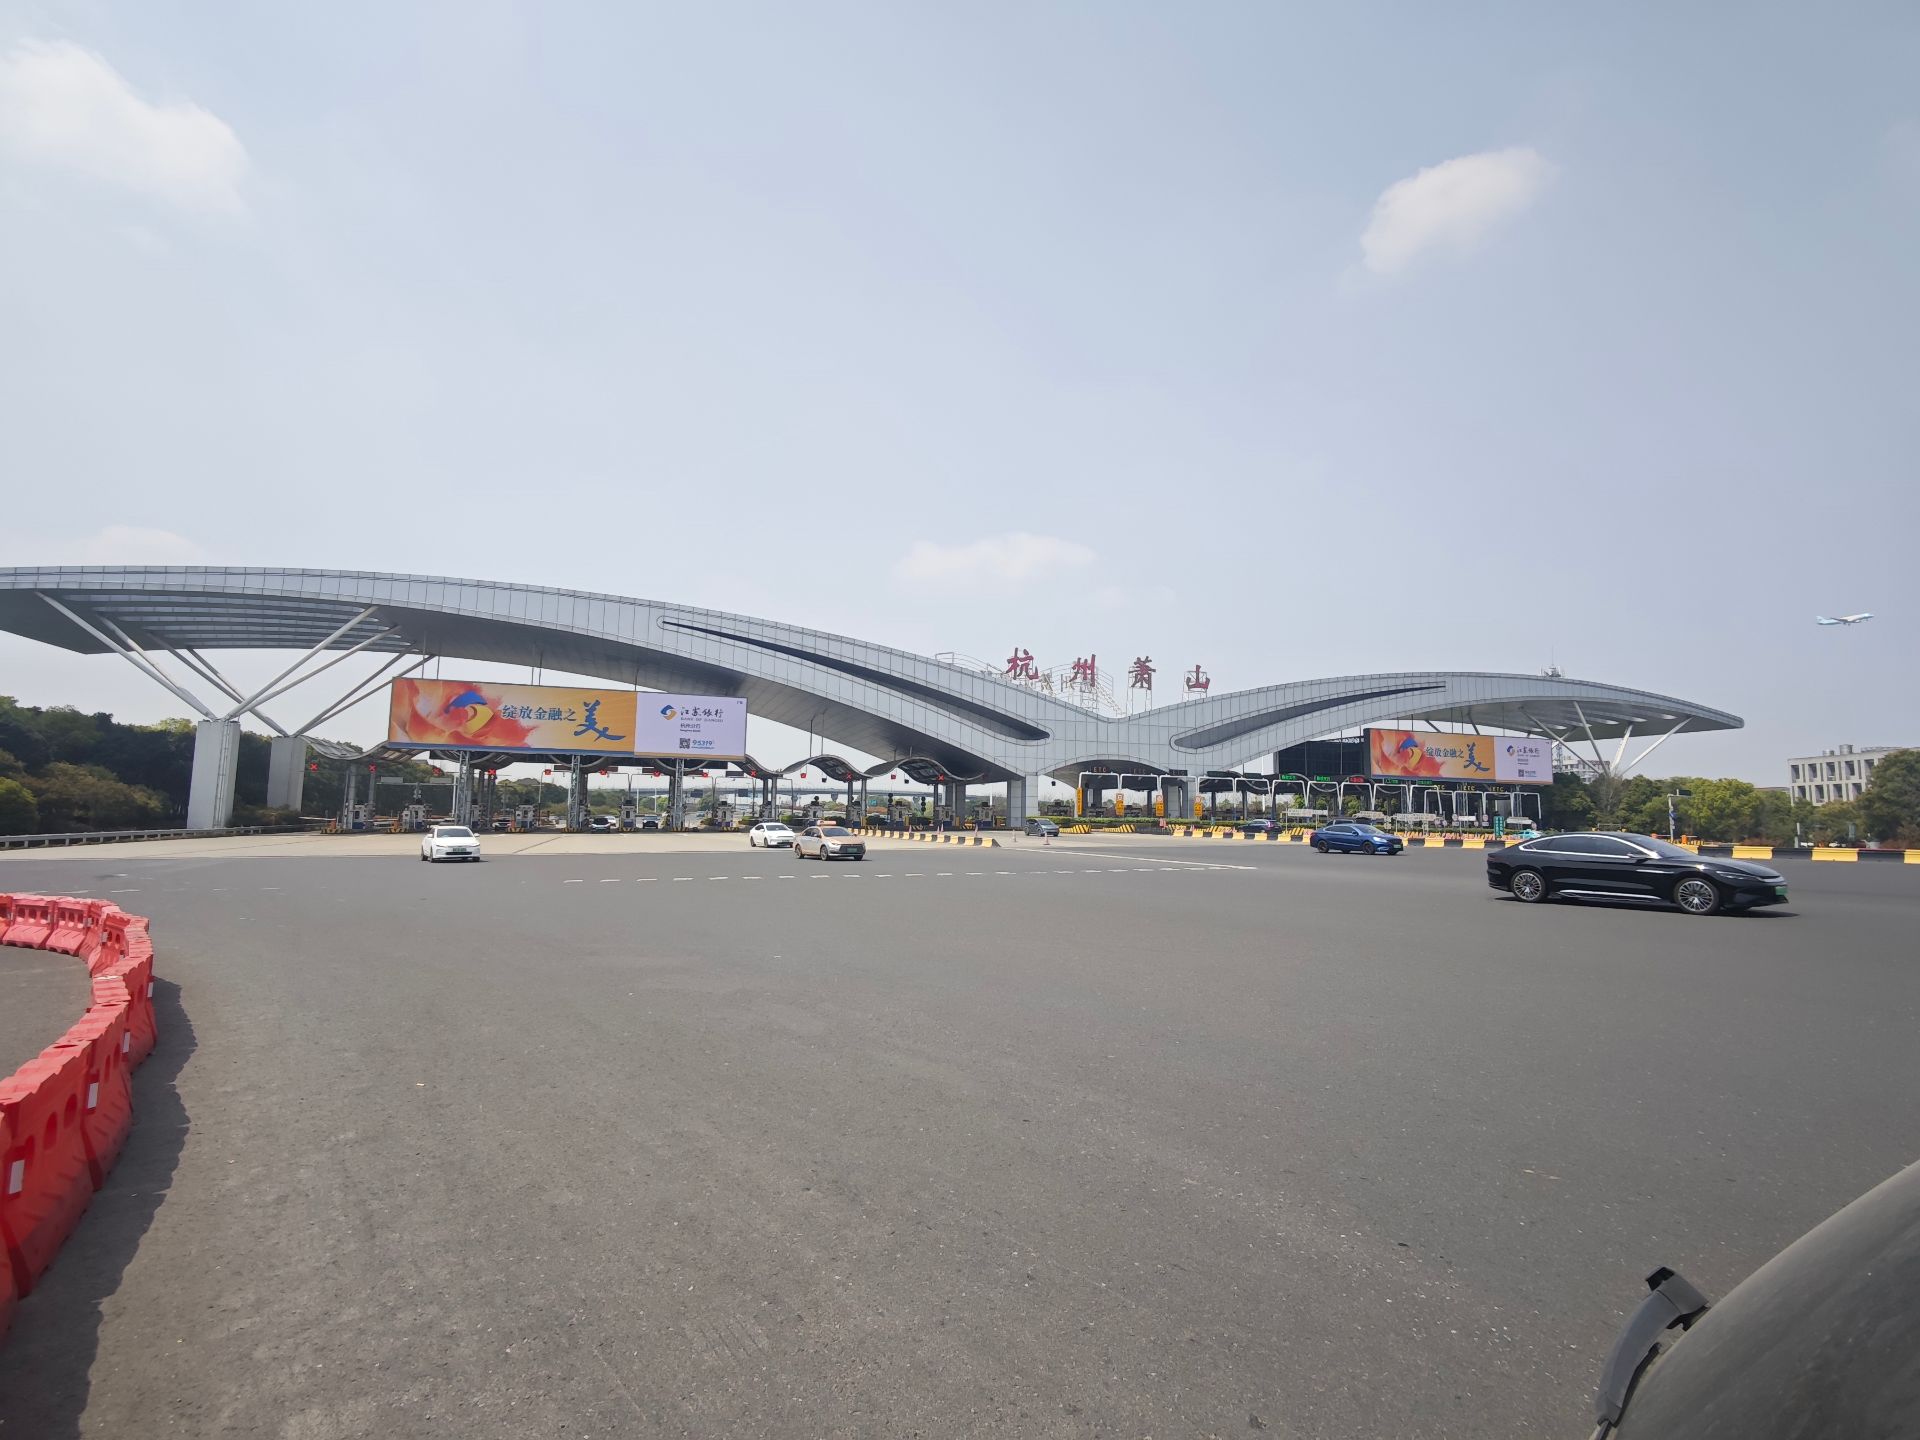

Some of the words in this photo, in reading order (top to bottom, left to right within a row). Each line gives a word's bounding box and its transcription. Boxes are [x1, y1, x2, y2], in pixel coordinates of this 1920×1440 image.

[1006, 647, 1211, 690] 杭州萧山
[502, 699, 626, 741] 绽放金融之美
[680, 706, 724, 718] 江苏银行
